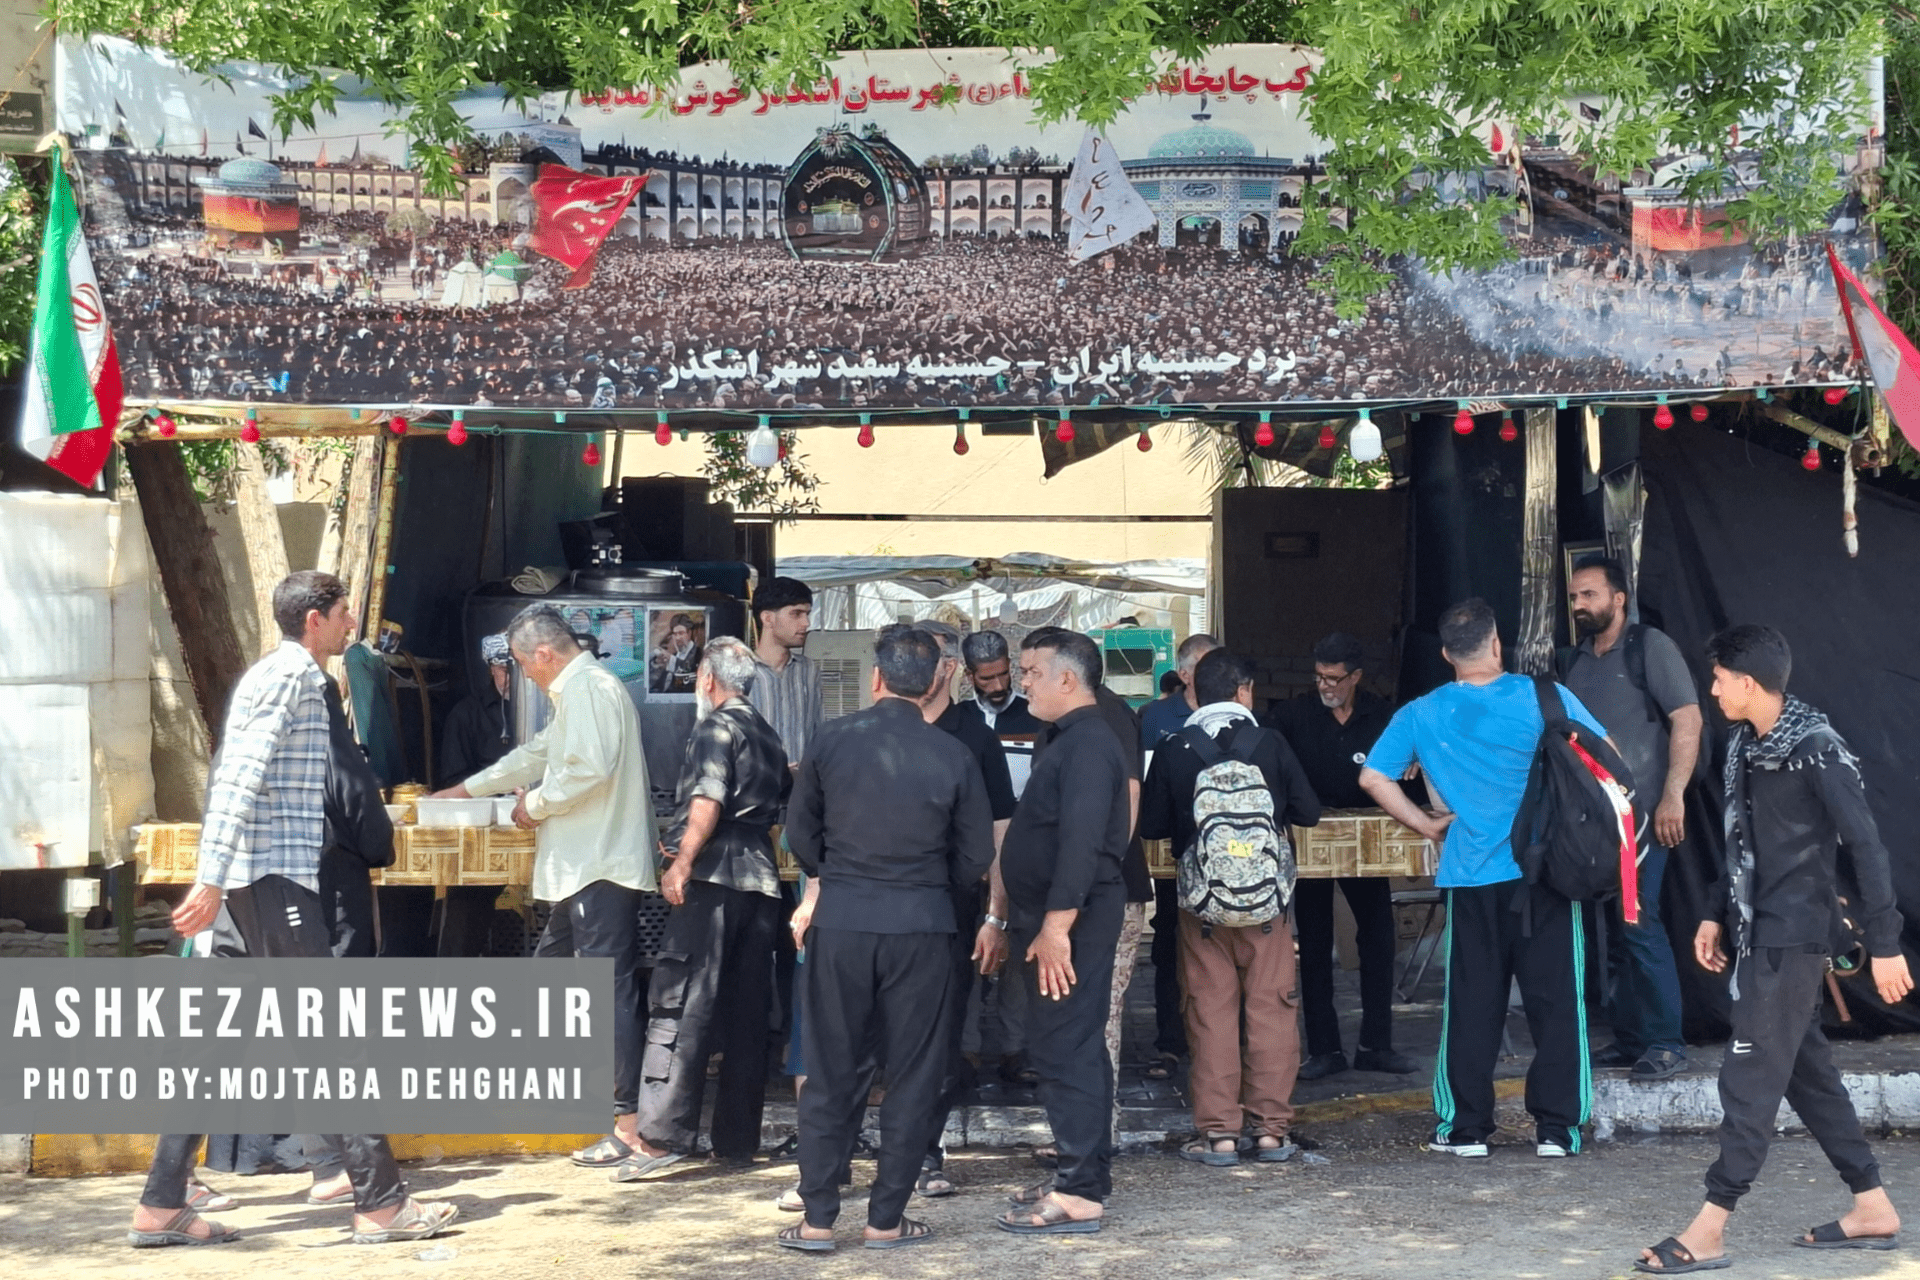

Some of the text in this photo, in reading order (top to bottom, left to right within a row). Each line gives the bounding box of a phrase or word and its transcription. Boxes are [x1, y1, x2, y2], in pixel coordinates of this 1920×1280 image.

[673, 79, 748, 116] خوش
[660, 348, 757, 389] اشکذر
[763, 350, 822, 388] شهر
[827, 349, 900, 387] سفید
[906, 352, 1011, 386] حسینیه
[1053, 344, 1131, 385] ایران
[1136, 348, 1242, 381] حسینیه
[1247, 346, 1297, 381] یزد
